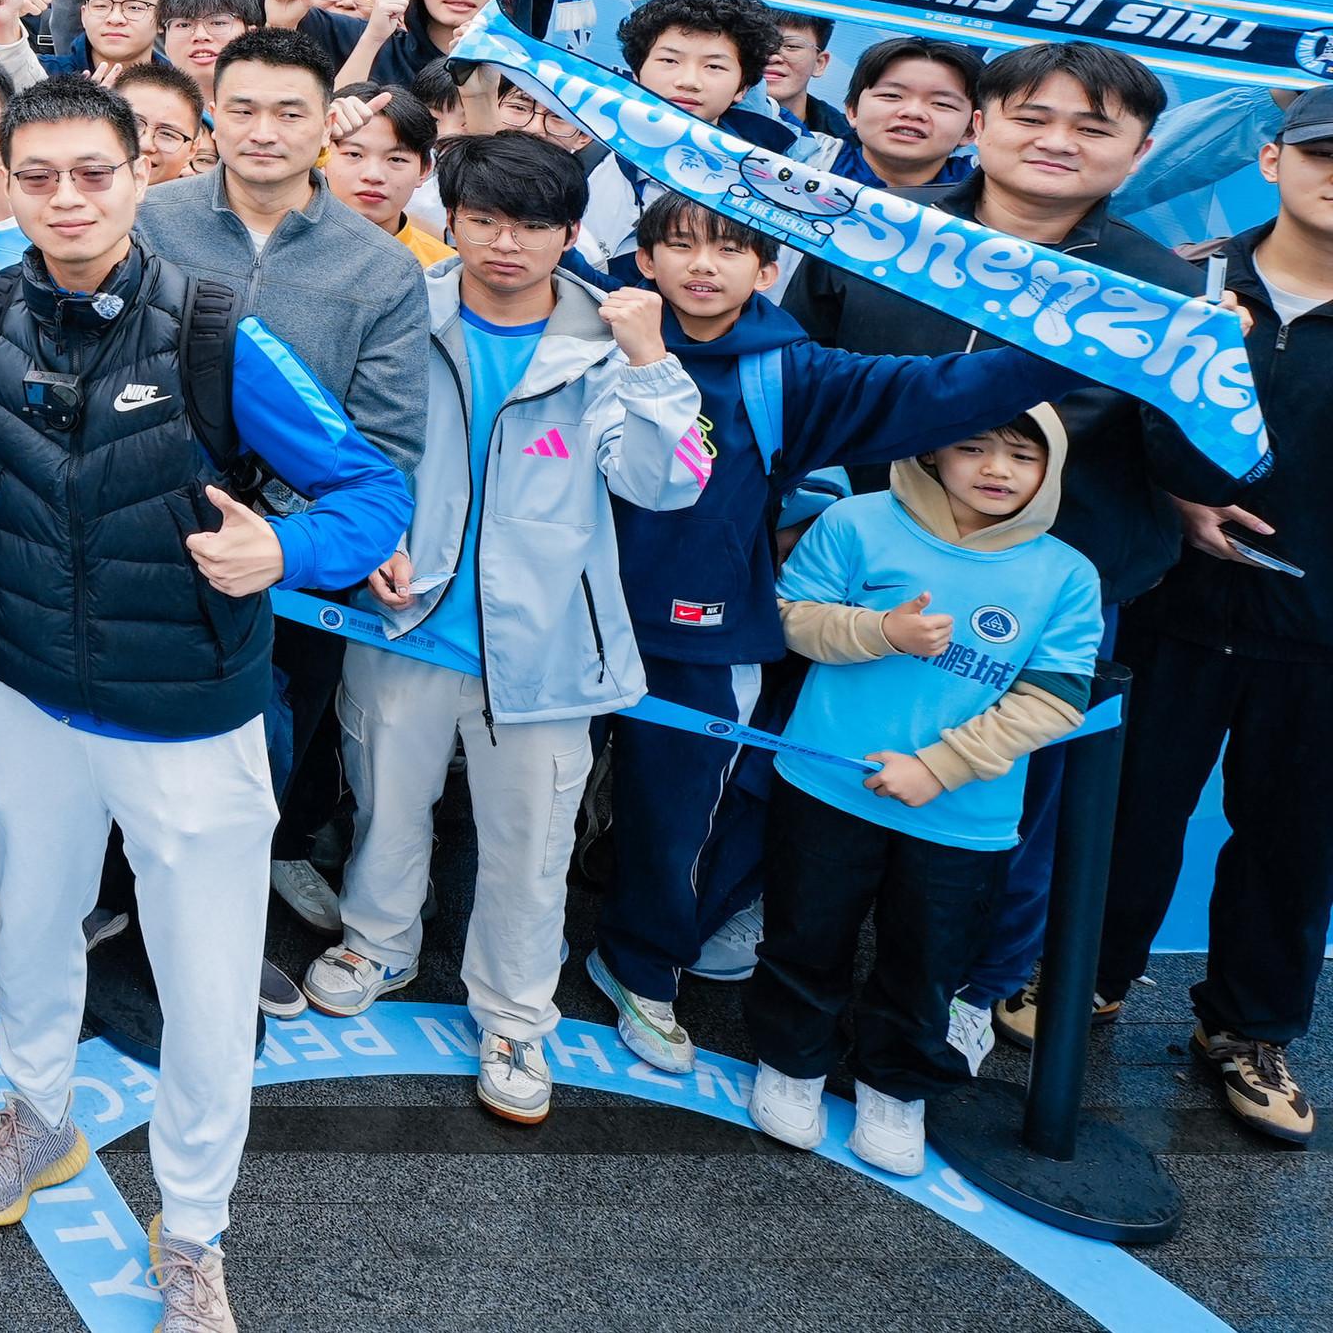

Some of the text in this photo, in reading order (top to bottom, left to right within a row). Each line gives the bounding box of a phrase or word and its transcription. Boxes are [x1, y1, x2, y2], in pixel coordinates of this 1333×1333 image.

[1104, 3, 1260, 52] THIS
[746, 201, 771, 222] ARE
[121, 383, 159, 401] NIKE
[705, 606, 720, 616] NK
